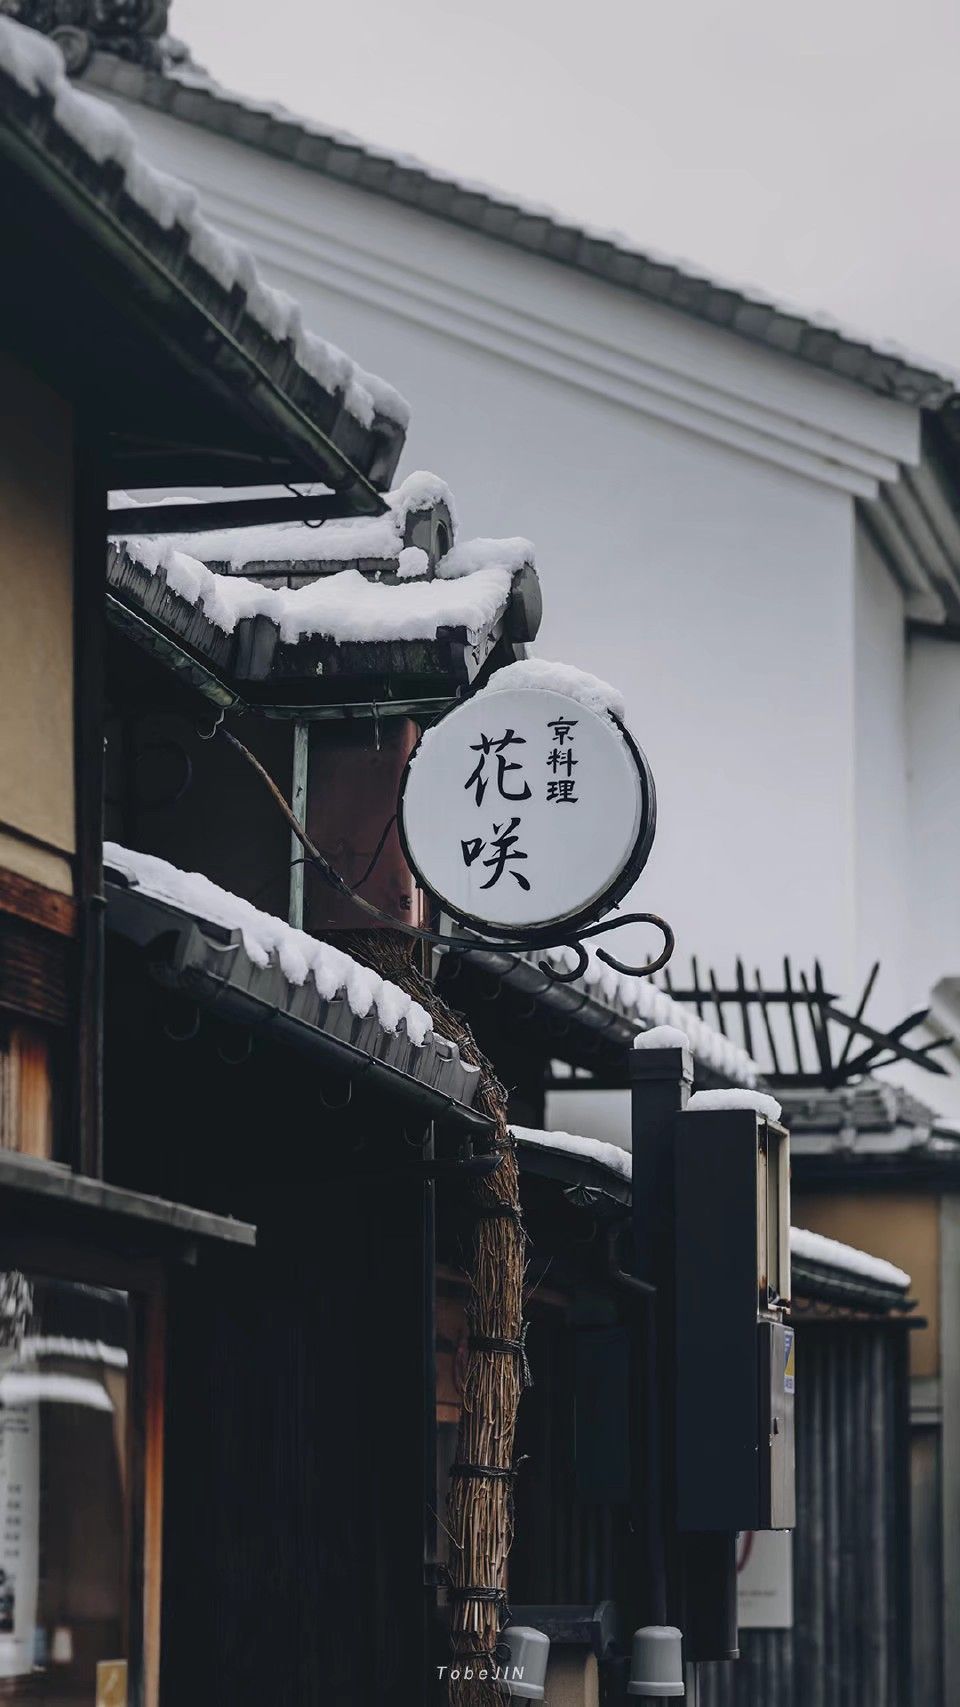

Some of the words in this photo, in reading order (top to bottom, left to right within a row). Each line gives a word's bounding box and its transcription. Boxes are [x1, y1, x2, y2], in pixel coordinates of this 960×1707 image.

[461, 729, 532, 891] 花咲
[546, 716, 579, 804] 京料理
